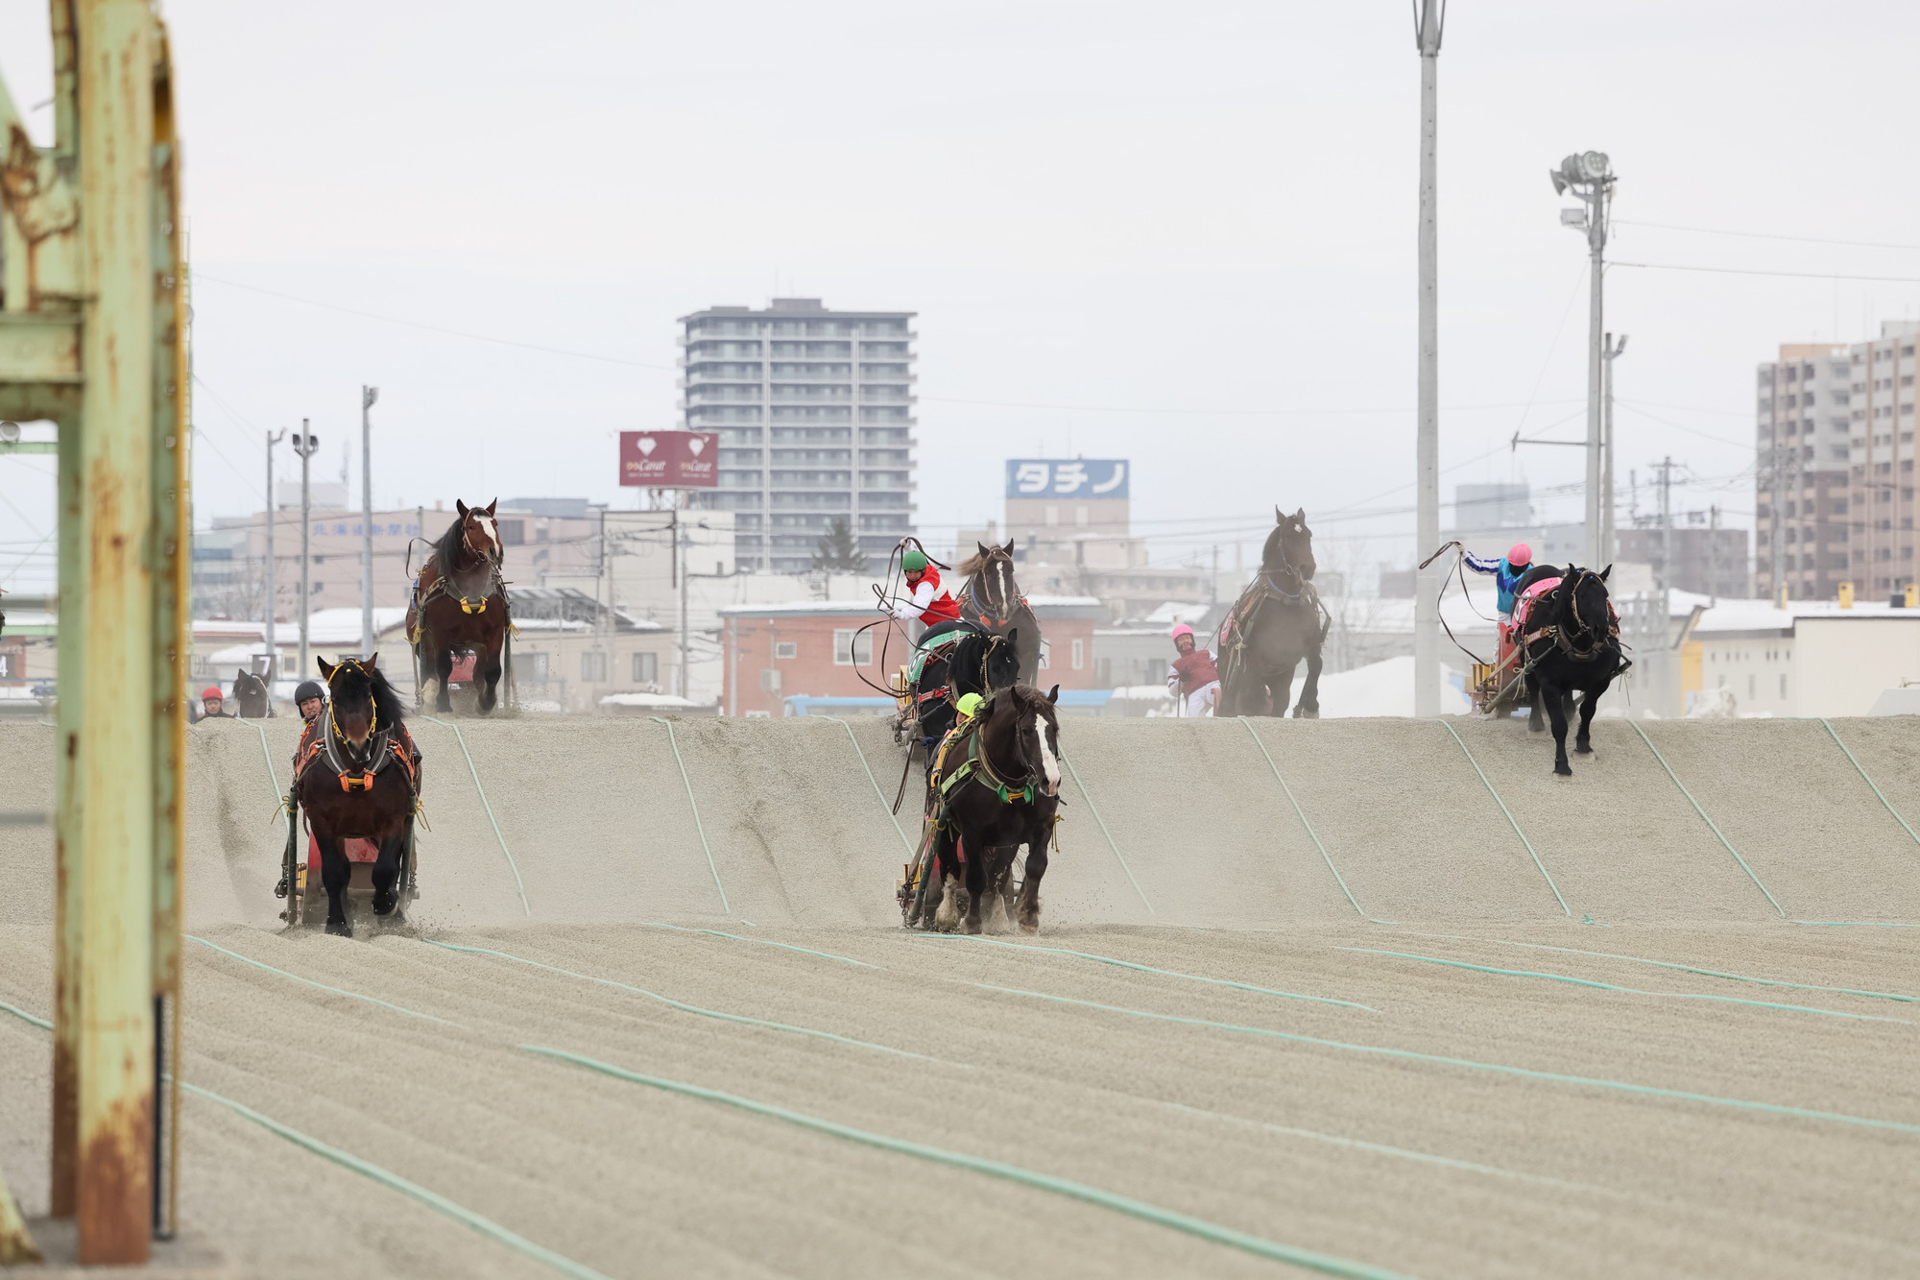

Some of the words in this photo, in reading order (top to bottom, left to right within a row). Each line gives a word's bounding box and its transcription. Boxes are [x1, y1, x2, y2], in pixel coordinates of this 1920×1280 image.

[1016, 462, 1124, 494] タチノ
[259, 656, 271, 676] 7
